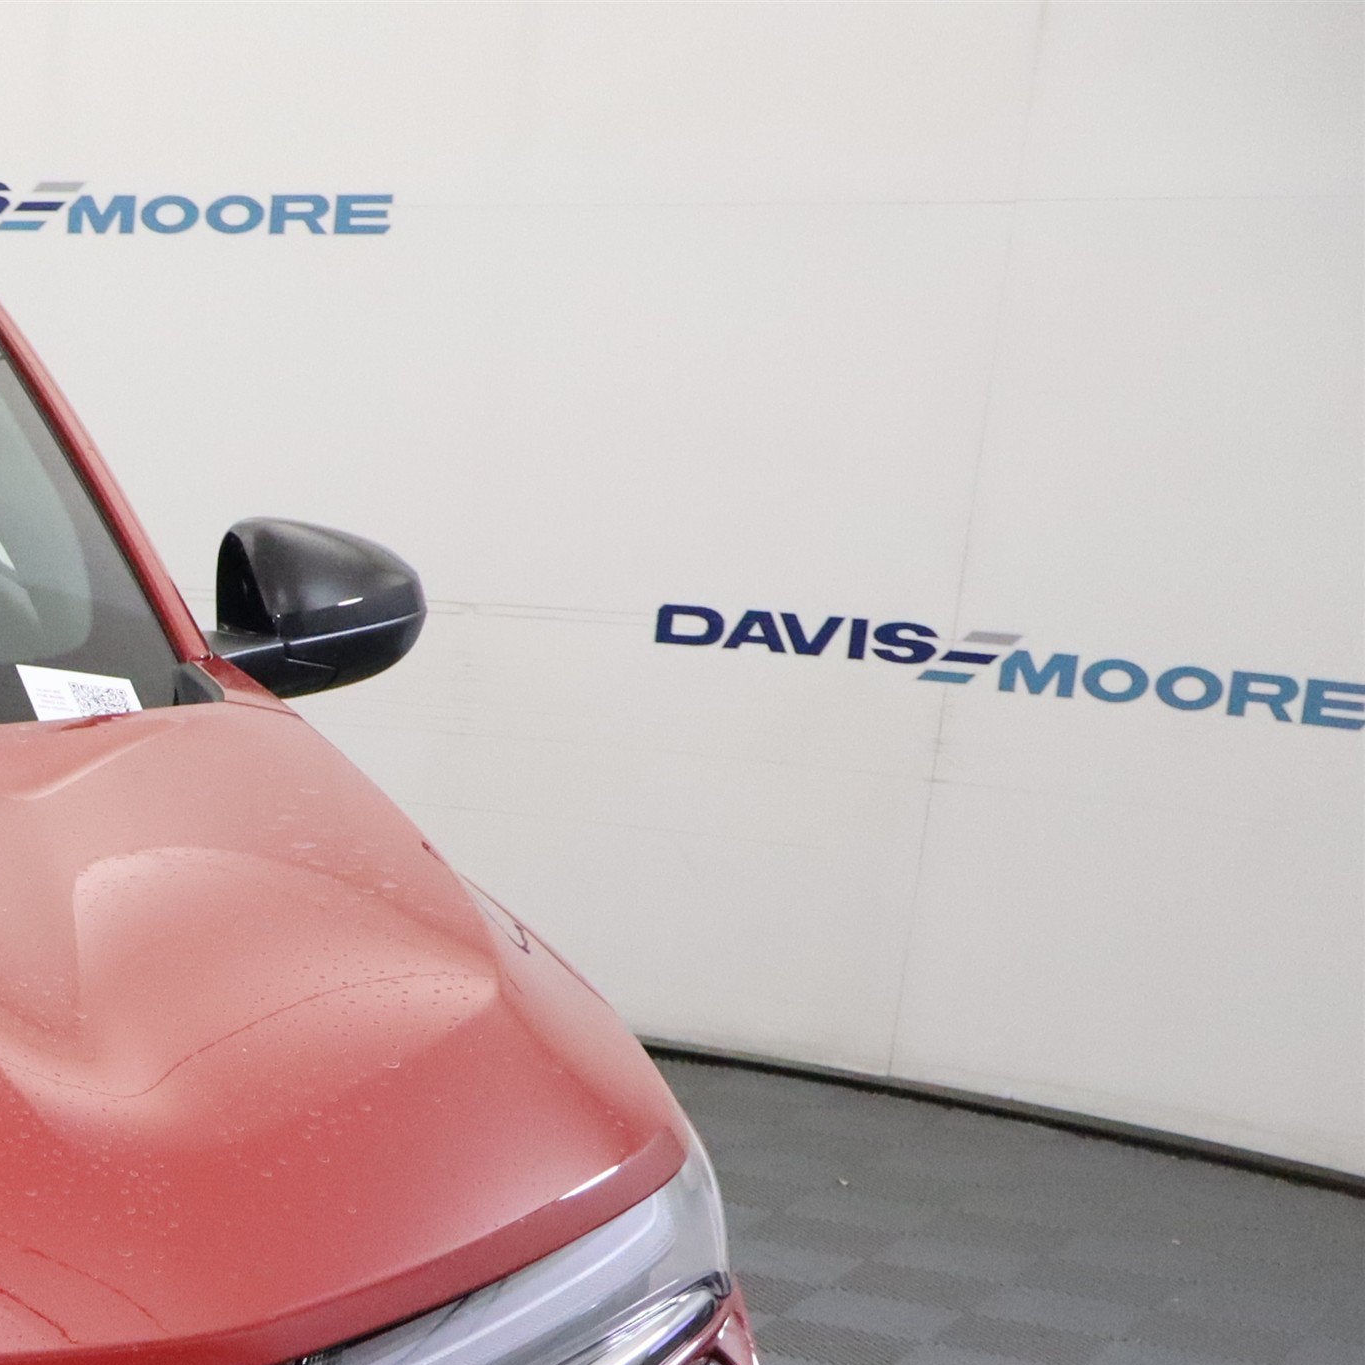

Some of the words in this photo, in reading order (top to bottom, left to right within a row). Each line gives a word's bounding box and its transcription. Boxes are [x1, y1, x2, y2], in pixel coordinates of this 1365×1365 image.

[65, 194, 394, 235] MOORE
[654, 604, 938, 664] DAVIS
[998, 649, 1365, 730] MOORE
